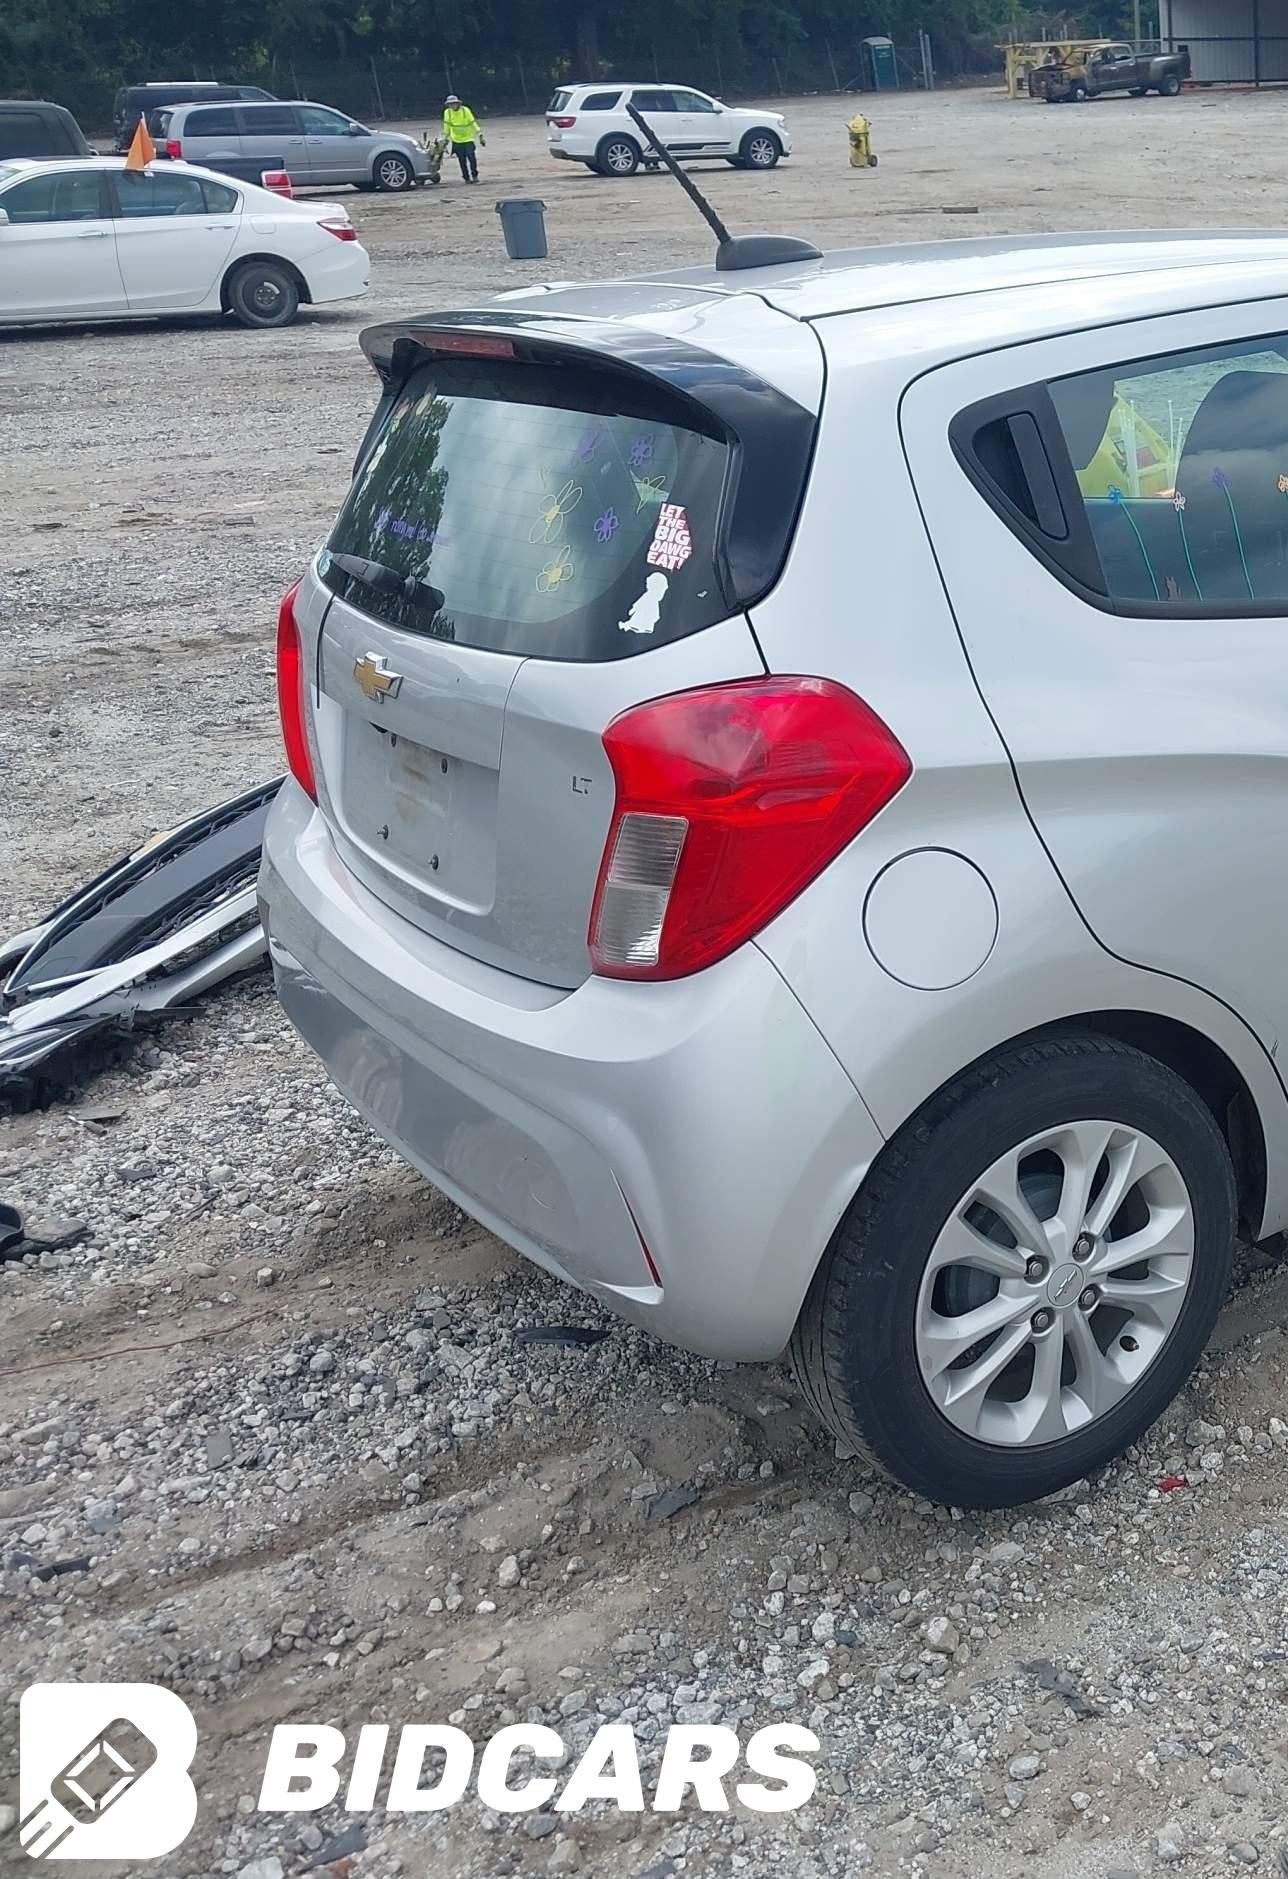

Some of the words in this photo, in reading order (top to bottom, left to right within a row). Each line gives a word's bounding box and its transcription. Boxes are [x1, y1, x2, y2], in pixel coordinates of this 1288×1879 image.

[660, 503, 686, 519] LET
[658, 516, 687, 529] THE
[654, 525, 691, 545] BIG
[649, 540, 692, 559] DAWG
[647, 551, 685, 570] EAT!
[572, 775, 593, 795] LT
